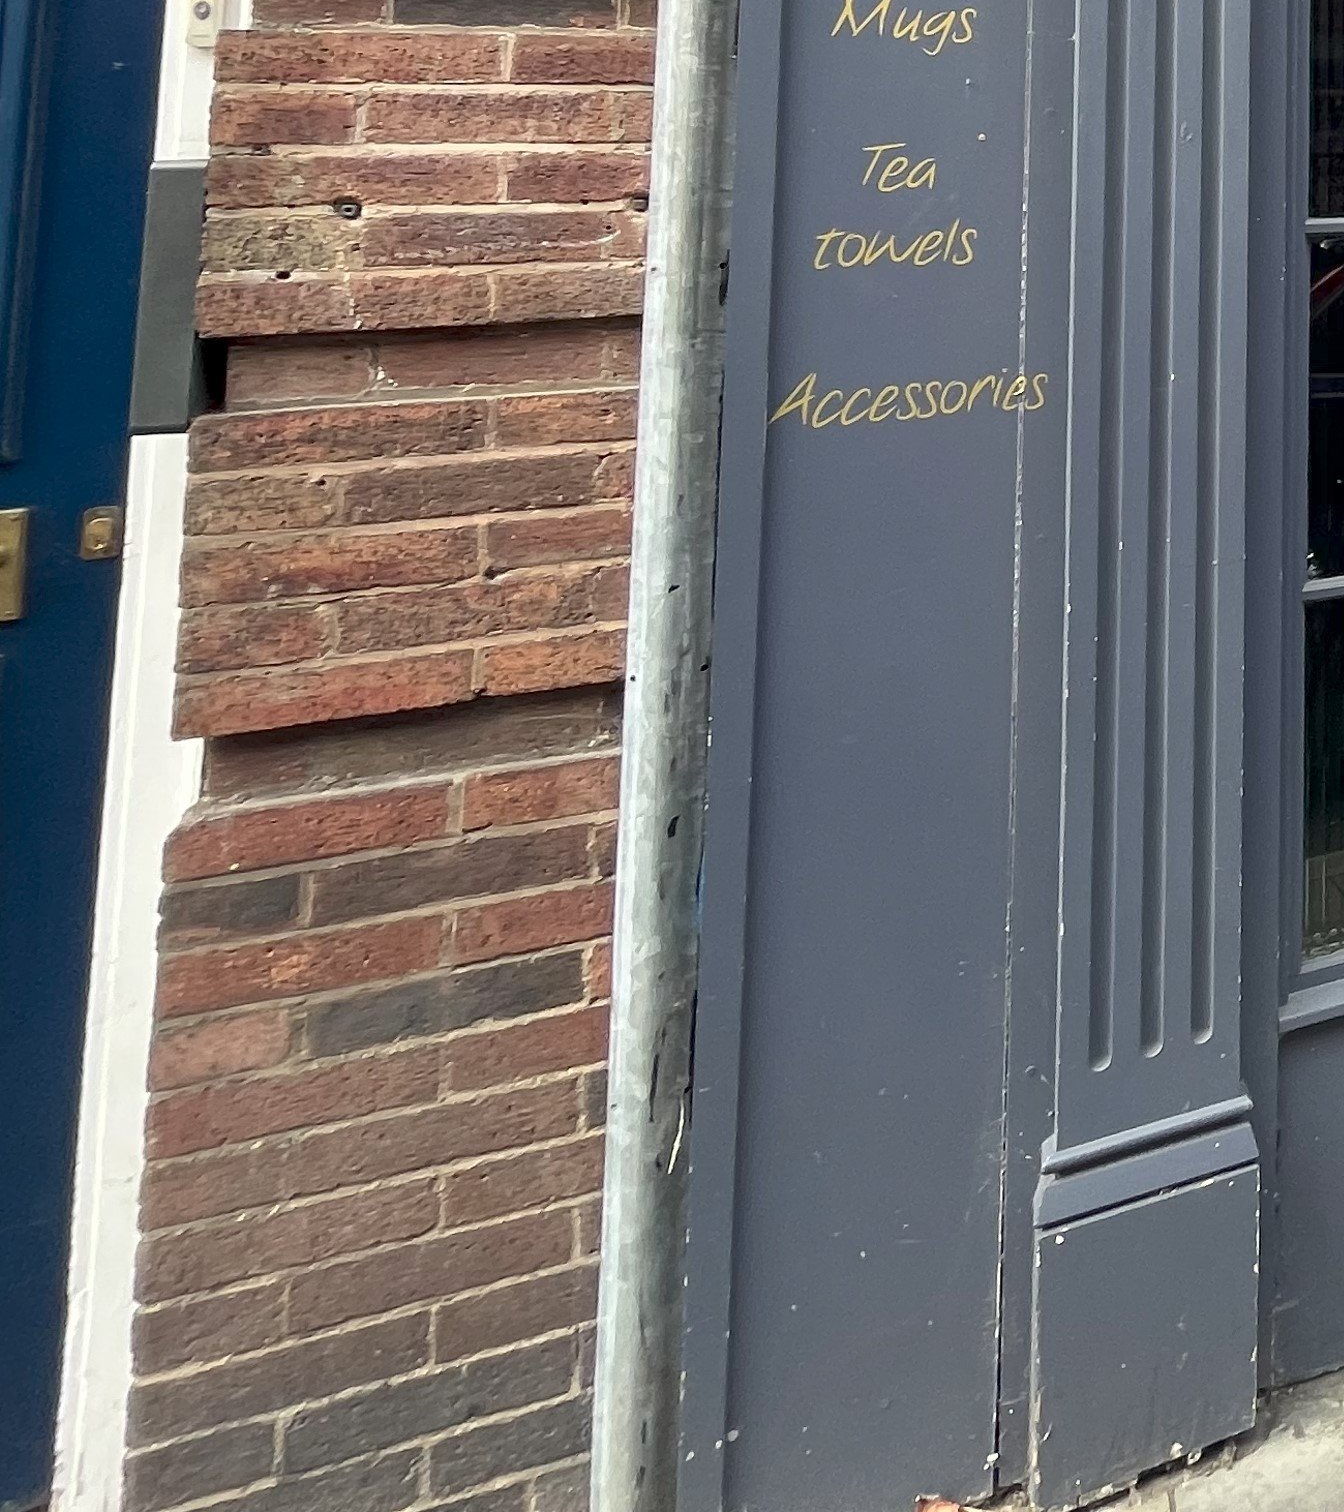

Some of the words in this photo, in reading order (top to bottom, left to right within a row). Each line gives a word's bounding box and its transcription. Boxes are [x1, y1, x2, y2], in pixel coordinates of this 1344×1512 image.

[861, 143, 936, 194] Tea
[813, 219, 977, 271] towels
[769, 368, 1049, 428] Accessories
